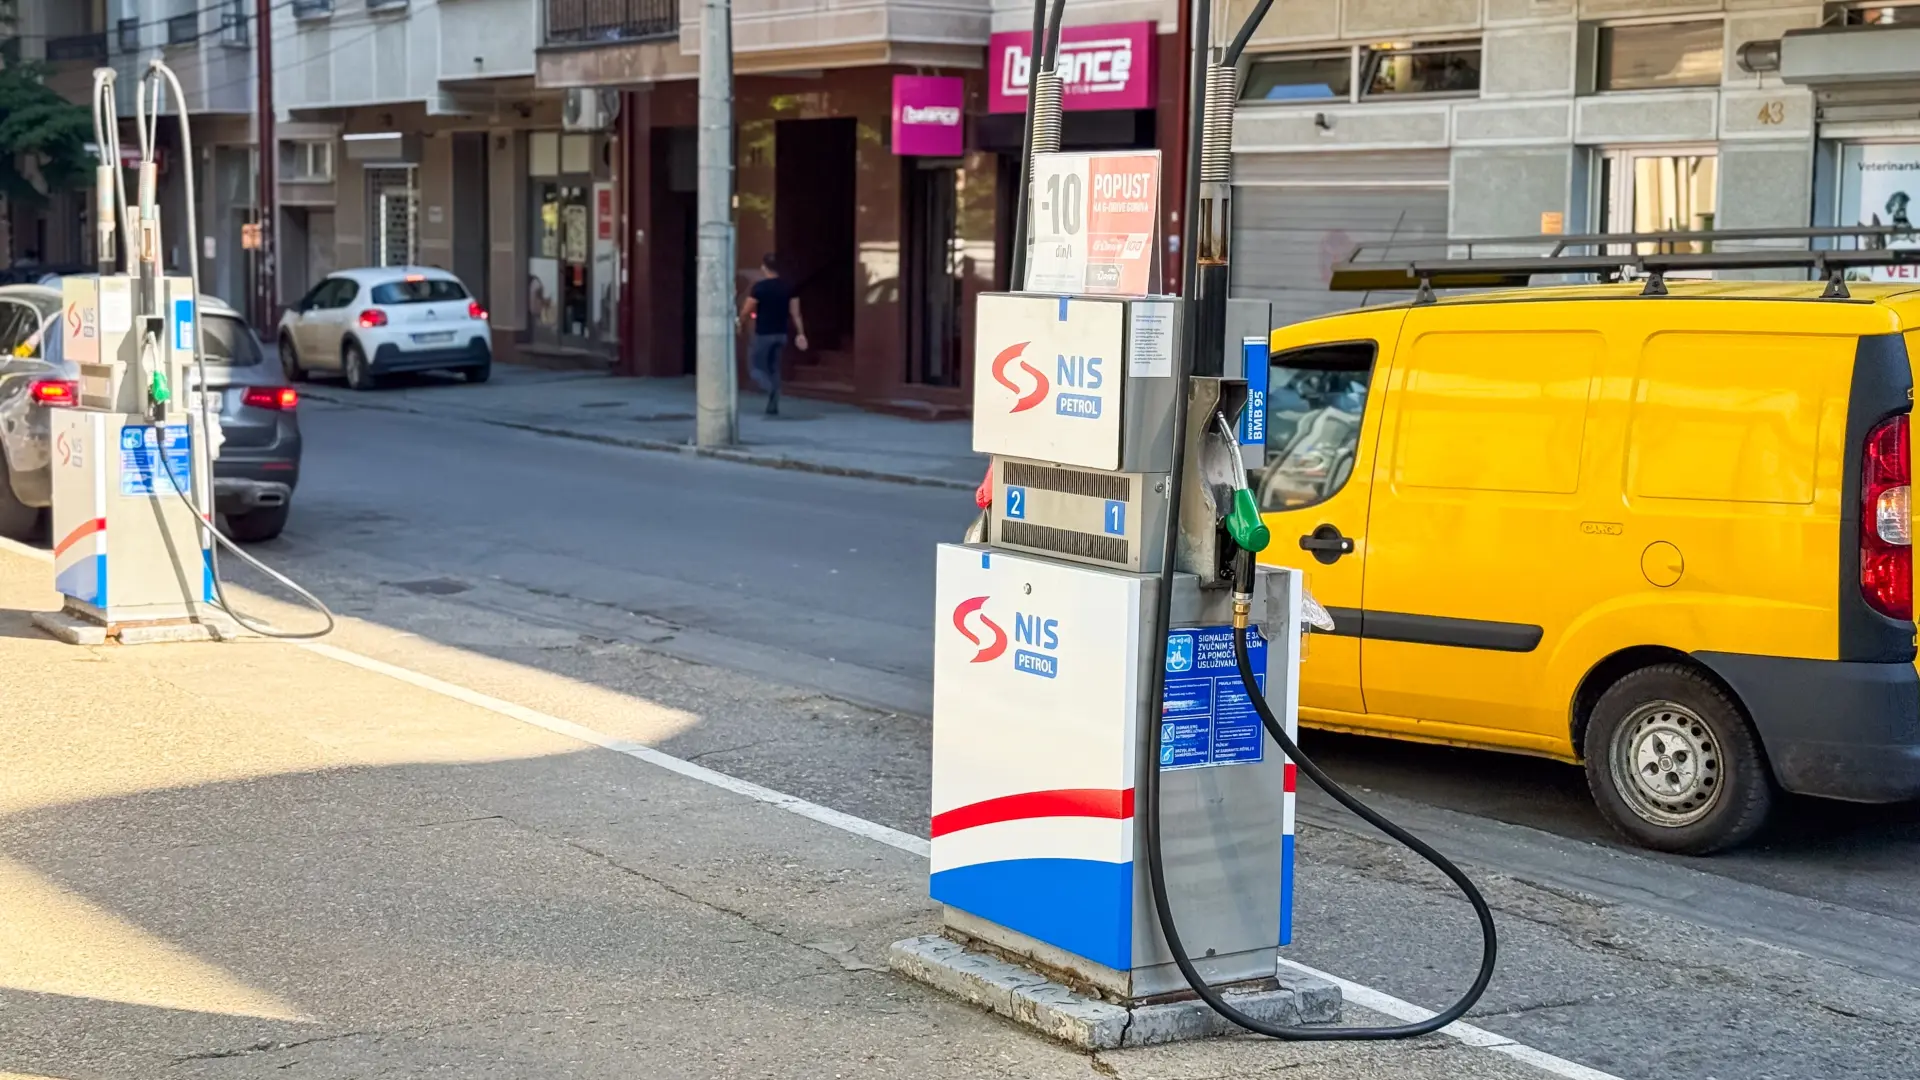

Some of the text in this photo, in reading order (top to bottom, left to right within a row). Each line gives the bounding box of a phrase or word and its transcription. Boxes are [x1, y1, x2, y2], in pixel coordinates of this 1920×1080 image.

[1757, 101, 1785, 124] 43
[1094, 173, 1151, 200] POPUST
[1041, 173, 1082, 235] -10
[1057, 354, 1103, 390] NIS
[1060, 397, 1098, 416] PETROL
[1253, 390, 1264, 440] BMB 95
[1010, 490, 1021, 515] 2
[1111, 505, 1119, 531] 1
[1015, 611, 1059, 650] NIS
[1018, 653, 1054, 675] PETROL
[1197, 652, 1206, 661] ZA
